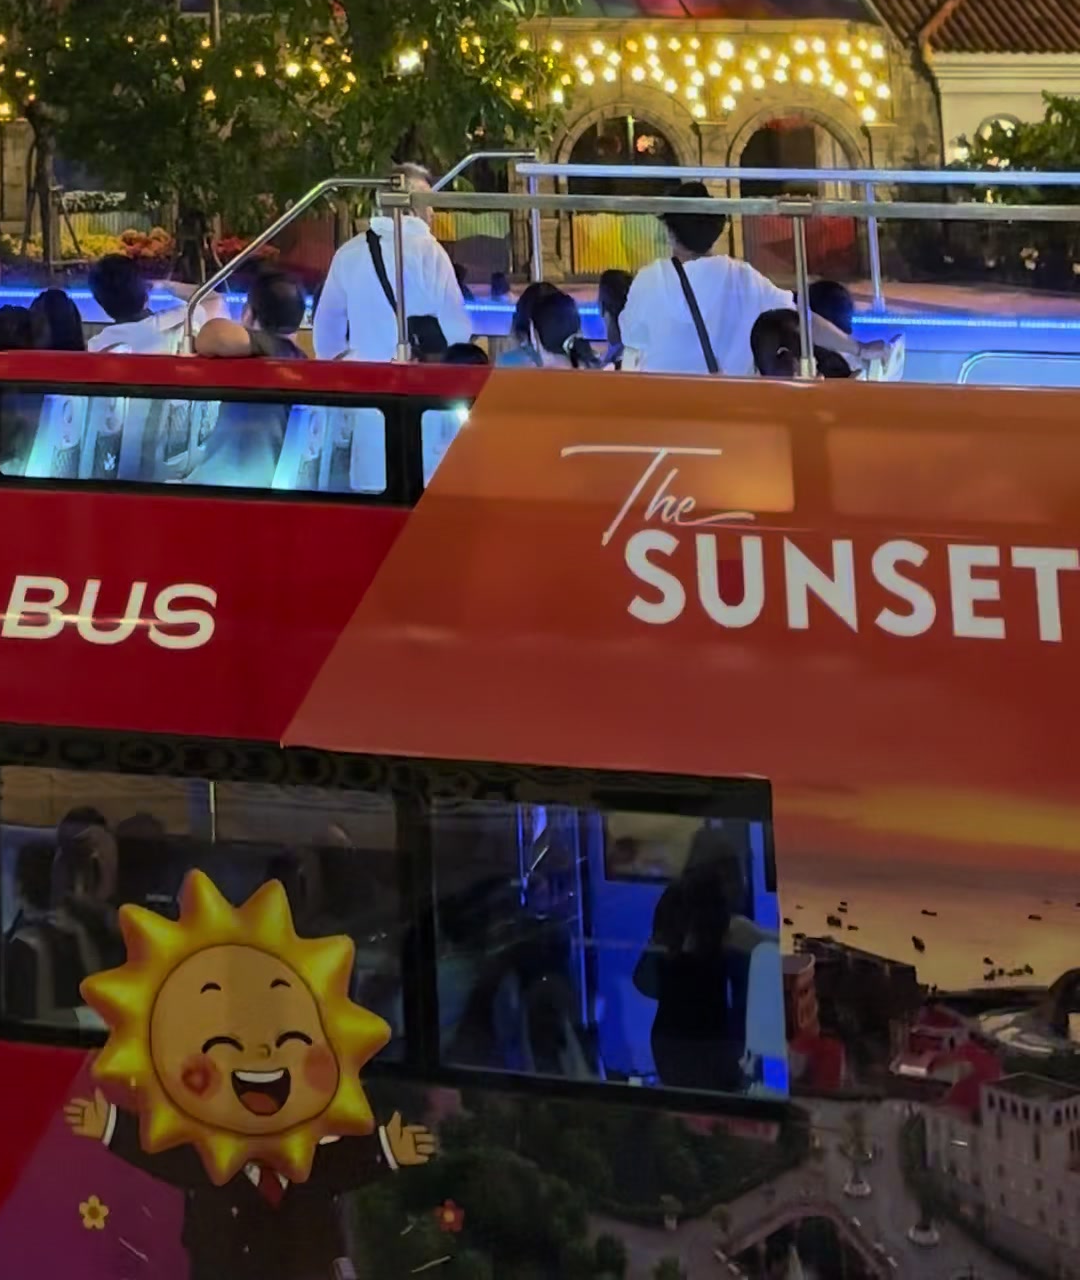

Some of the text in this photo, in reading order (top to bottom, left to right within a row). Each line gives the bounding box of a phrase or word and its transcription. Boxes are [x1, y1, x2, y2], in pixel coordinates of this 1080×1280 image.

[560, 444, 756, 547] The
[1, 574, 219, 650] BUS
[624, 529, 1080, 643] SUNSET
